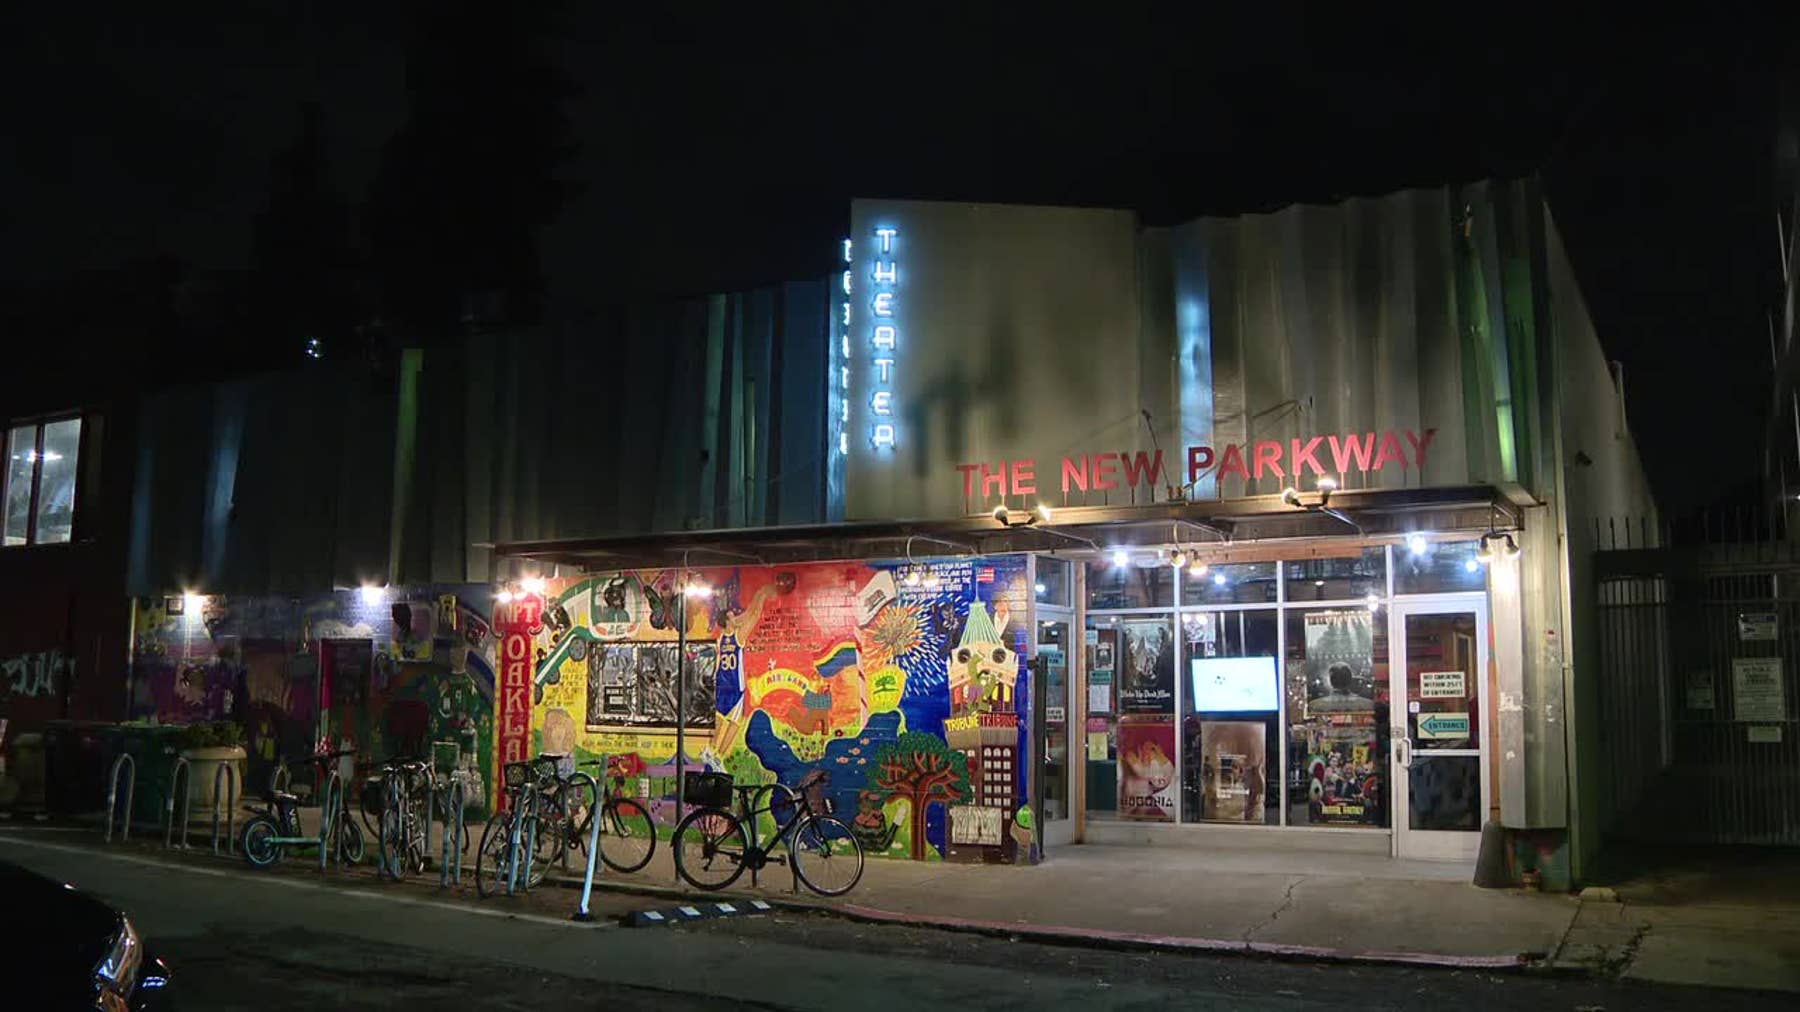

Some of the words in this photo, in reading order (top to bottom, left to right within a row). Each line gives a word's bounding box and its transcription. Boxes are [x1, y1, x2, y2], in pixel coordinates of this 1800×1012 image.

[874, 228, 896, 449] THEATER
[955, 459, 1037, 497] THE
[1061, 449, 1163, 492] NEW
[1187, 427, 1437, 481] PARKWAY
[721, 653, 737, 671] 30
[503, 634, 526, 814] OAKLA
[980, 713, 1018, 728] TRIBUNE
